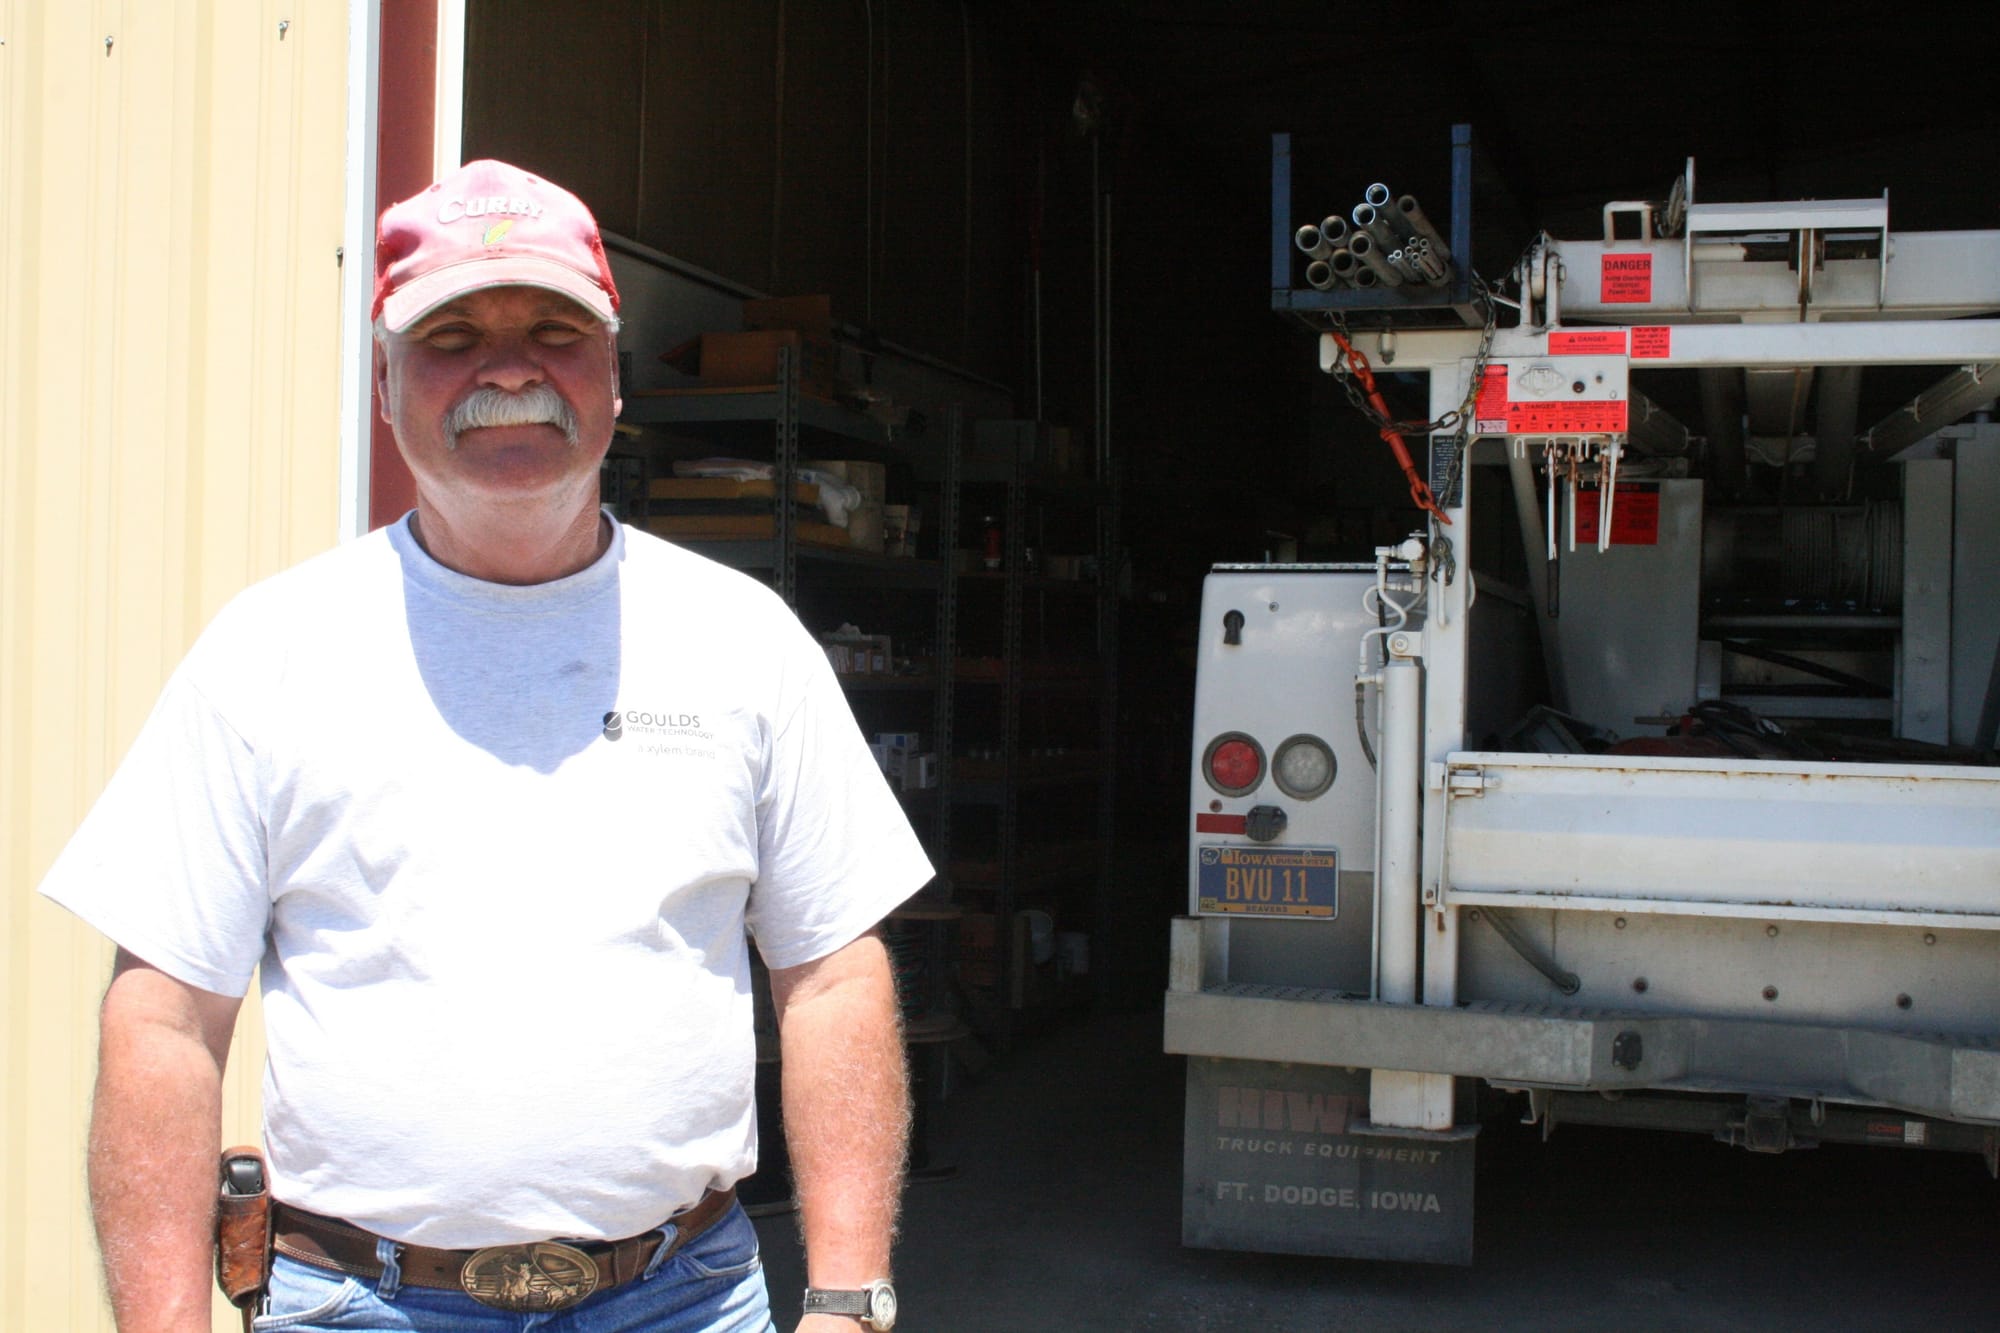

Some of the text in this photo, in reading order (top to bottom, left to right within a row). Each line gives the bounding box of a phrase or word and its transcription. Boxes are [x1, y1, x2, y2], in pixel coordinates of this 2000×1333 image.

[437, 196, 543, 224] CURRY
[1604, 260, 1651, 271] DANGER
[1577, 335, 1607, 343] DANGER
[626, 710, 700, 728] GOULDS
[627, 725, 714, 740] WATER TECHNOLOGY
[647, 744, 682, 757] xylem
[1275, 855, 1304, 865] BUENA
[1226, 867, 1309, 902] BVU 11
[1218, 1086, 1369, 1135] HIW
[1216, 1137, 1294, 1155] TRUCK
[1216, 1181, 1254, 1202] FT.
[1371, 1191, 1441, 1213] IOWA
